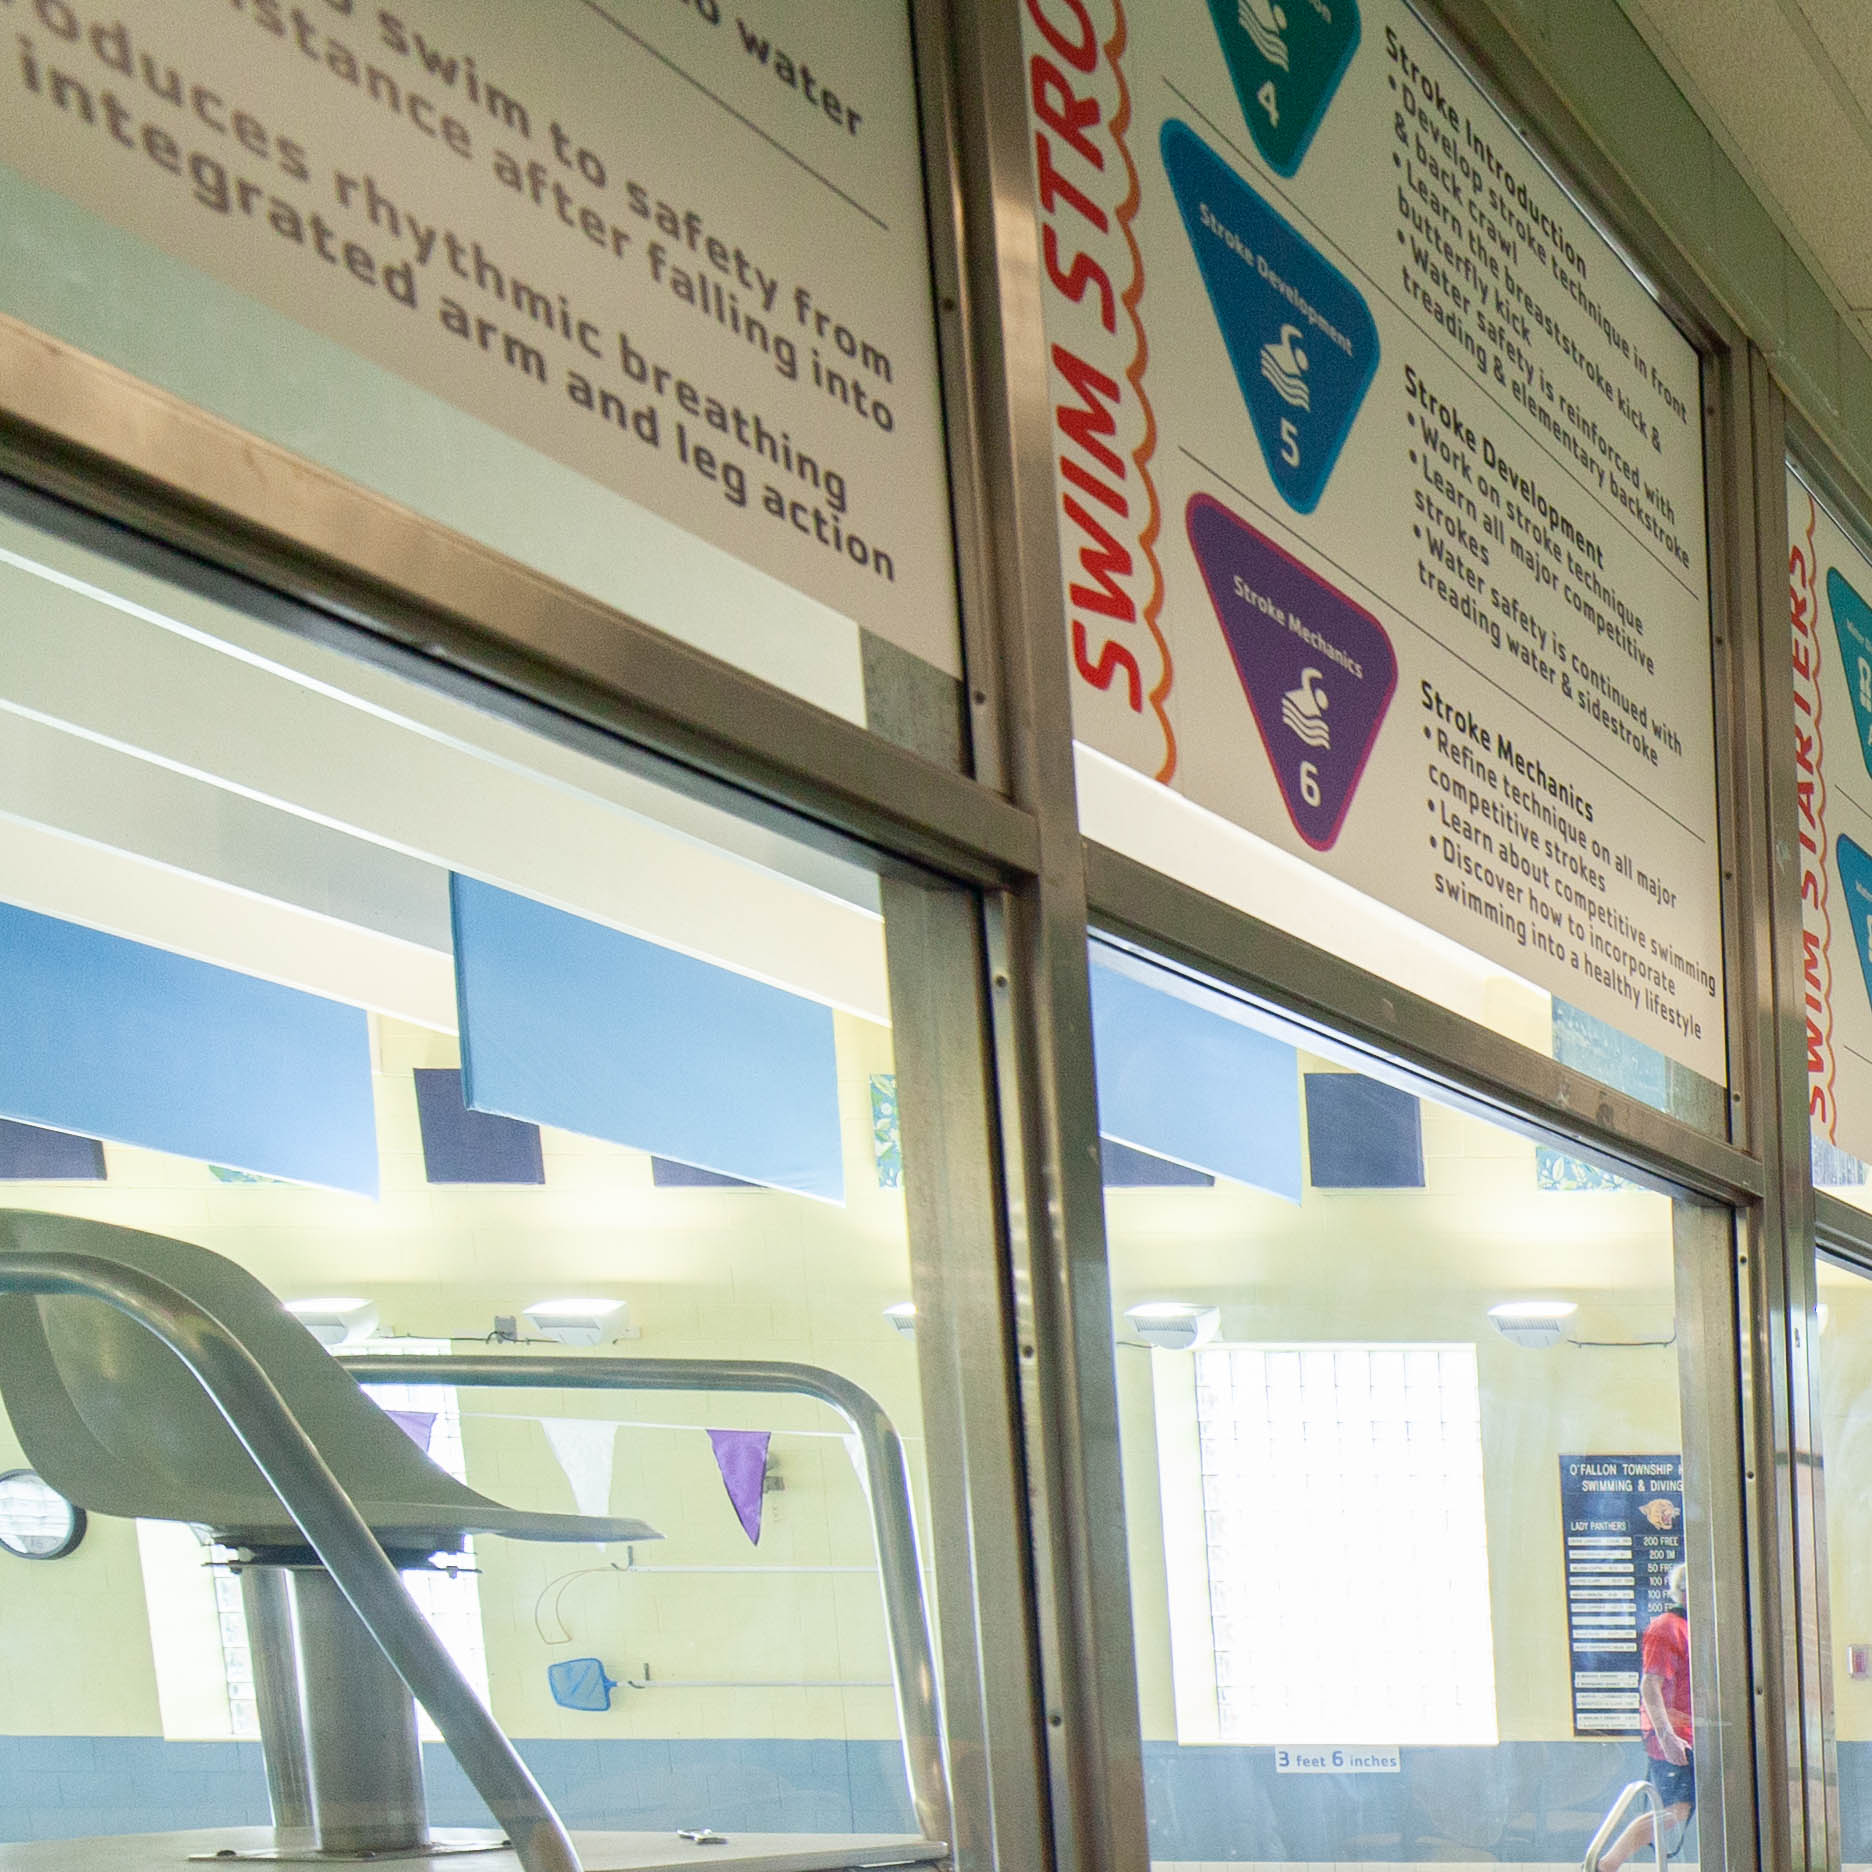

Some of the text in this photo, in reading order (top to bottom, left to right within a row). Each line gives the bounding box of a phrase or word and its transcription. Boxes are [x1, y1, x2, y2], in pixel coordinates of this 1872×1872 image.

[735, 17, 862, 136] water
[1257, 80, 1278, 129] 4
[1384, 24, 1586, 280] Stroke Introduction
[232, 0, 895, 433] stance after falling into
[378, 9, 894, 385] swim to safety from
[1393, 109, 1518, 266] & back crawl
[1396, 184, 1532, 347] butterfly kick
[1400, 81, 1687, 425] Develop stroke technique in front
[16, 33, 895, 582] integrated arm and leg action
[335, 169, 603, 359] rhythmic
[619, 332, 848, 514] breathing
[1200, 203, 1353, 358] Stroke Development
[1405, 158, 1662, 454] Learn the breaststroke kick &
[1280, 417, 1300, 468] 5
[1401, 264, 1689, 570] treading & elementary backstroke
[1409, 234, 1675, 525] Water safety is reinforced with
[1051, 342, 1142, 713] SWIM
[1404, 363, 1604, 571] Stroke Development
[1419, 414, 1643, 636] Work on stroke technique
[1234, 575, 1363, 681] Stroke Mechanics
[1425, 526, 1682, 757] Water safety is continued with
[1299, 760, 1321, 808] 6
[1420, 679, 1593, 823] Stroke Mechanics
[1428, 763, 1606, 892] competitive strokes
[1436, 727, 1677, 908] Refine technique on all major
[1434, 872, 1701, 1040] swimming into a healthy lifestyle
[1439, 798, 1716, 998] Learn about competitive swimming
[1441, 835, 1675, 996] Discover how to incorporate
[1570, 1463, 1673, 1476] O'FALLON TOWNSHIP
[1570, 1521, 1627, 1531] LADY PANTHERS
[1582, 1479, 1684, 1492] SWIMMING & DIVING
[1643, 1536, 1679, 1546] 200 FREE
[1649, 1550, 1664, 1560] 200
[1278, 1750, 1398, 1767] 3 feet 6 inches
